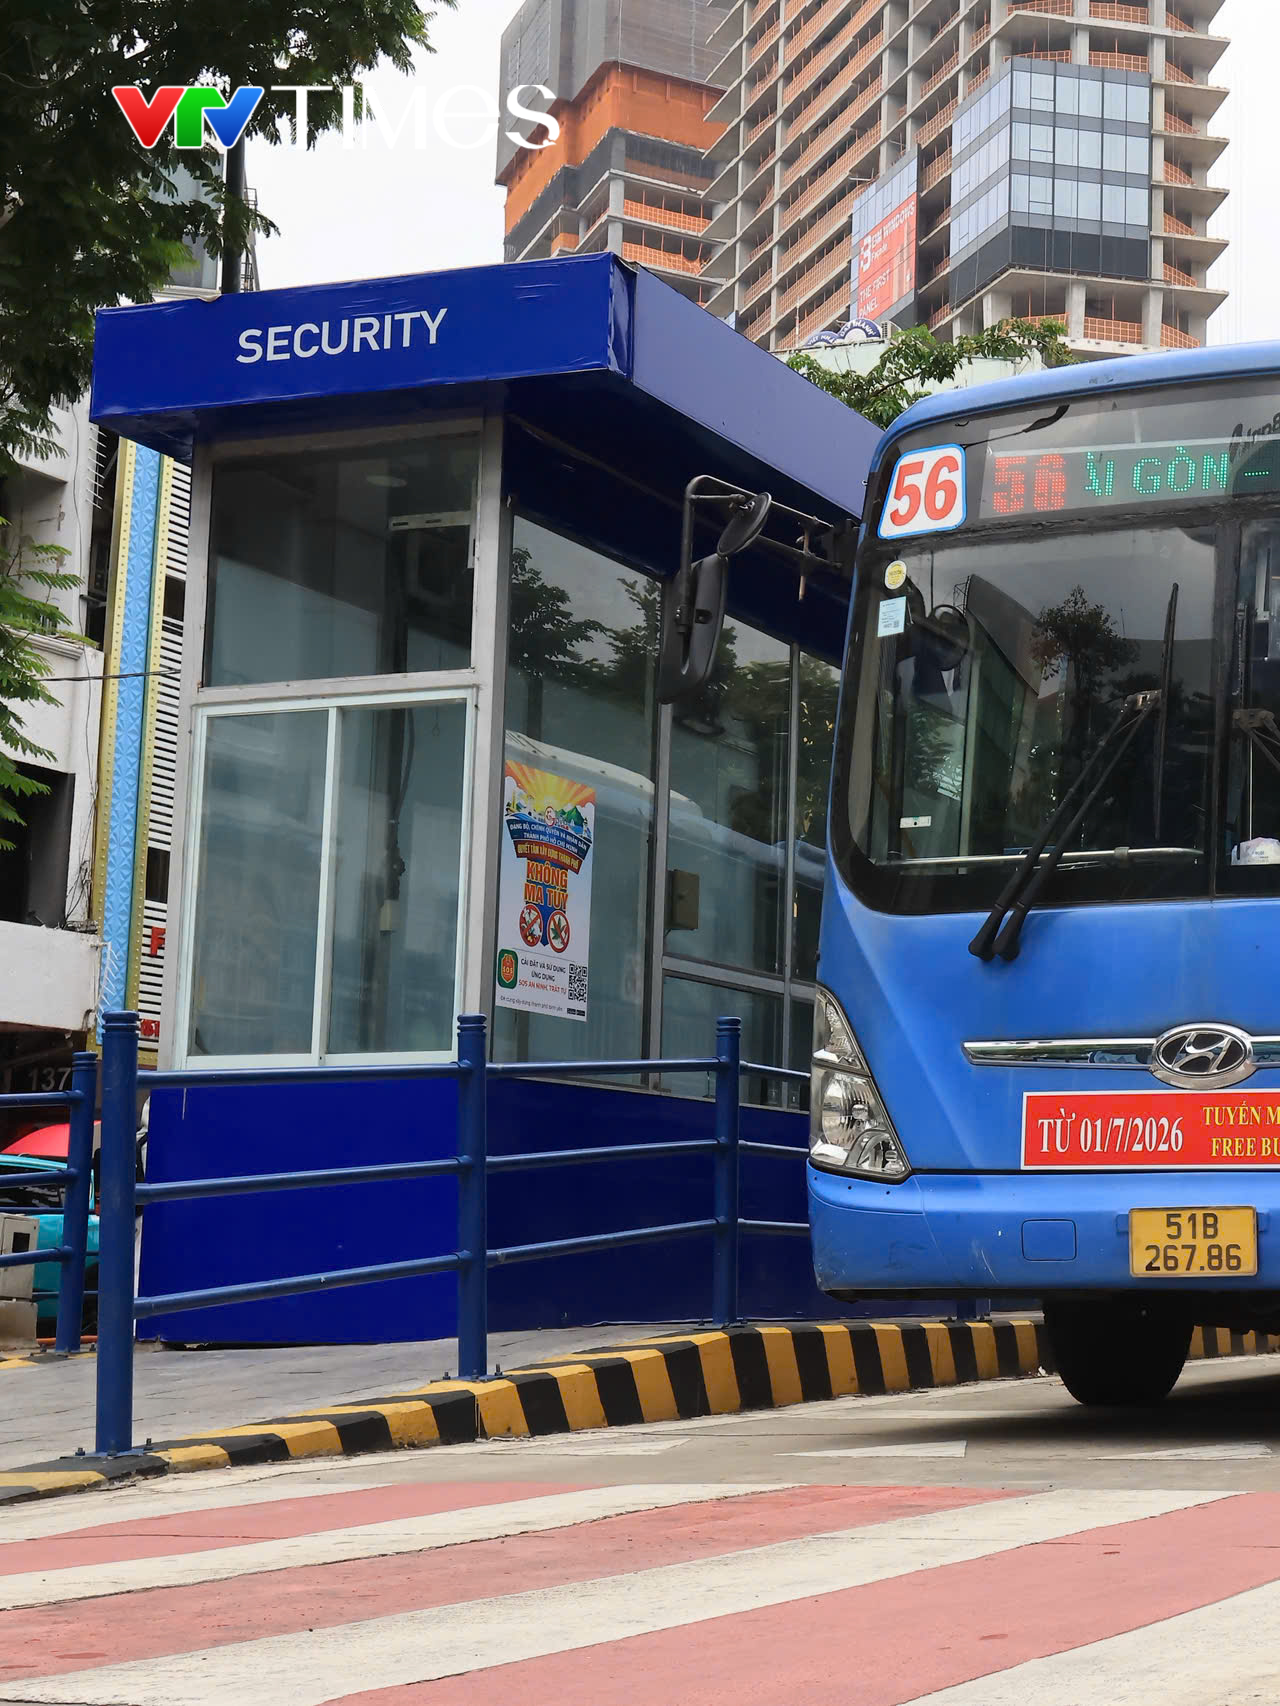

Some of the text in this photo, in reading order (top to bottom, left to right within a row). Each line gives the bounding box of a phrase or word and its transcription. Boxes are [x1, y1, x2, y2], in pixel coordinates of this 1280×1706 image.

[860, 269, 890, 303] THE FIRST
[236, 308, 448, 363] SECURITY
[1132, 446, 1229, 494] GÒN
[890, 456, 959, 526] 56
[527, 861, 568, 889] KHÔNG
[524, 883, 568, 911] MA TÚY
[1203, 1100, 1261, 1127] TUYẾN
[1038, 1108, 1183, 1153] TỪ 01/7/2026
[1211, 1137, 1256, 1157] FREE
[1166, 1212, 1218, 1240] 51B
[1145, 1244, 1242, 1272] 267.86
